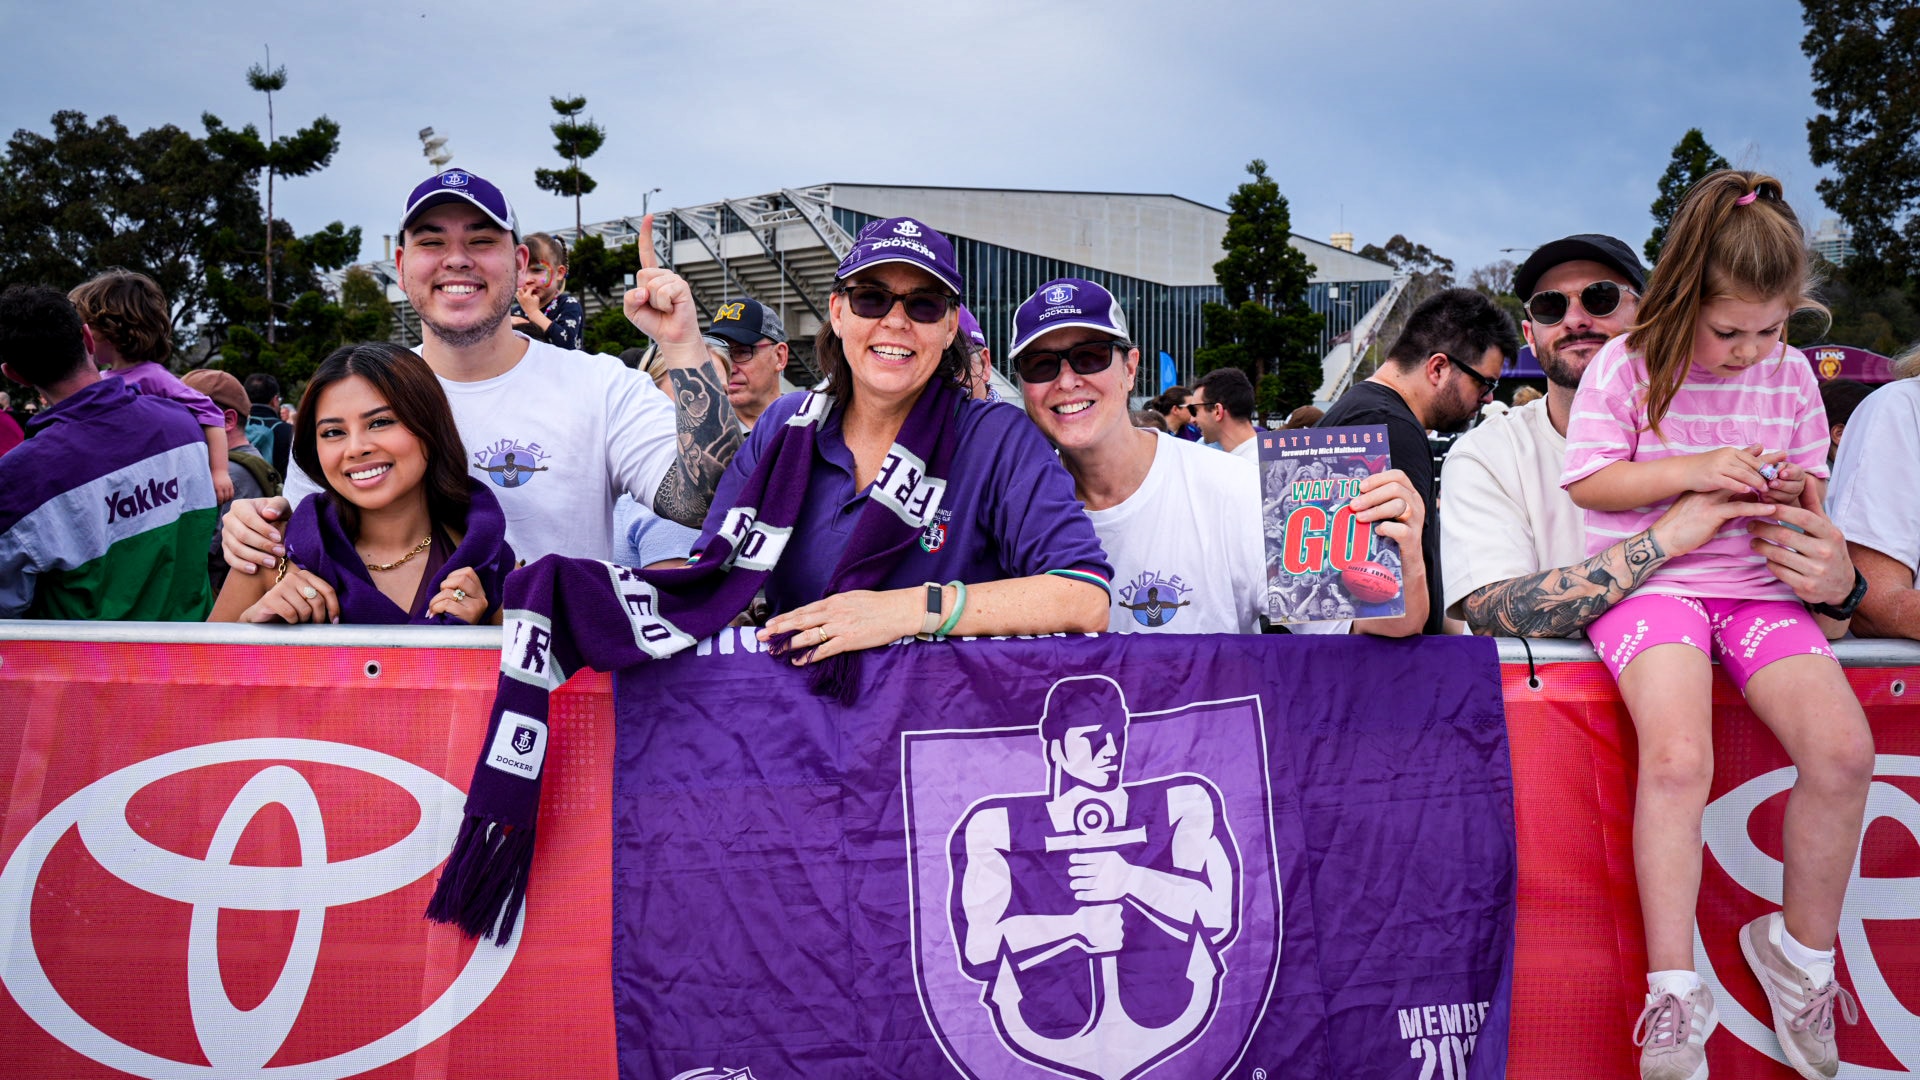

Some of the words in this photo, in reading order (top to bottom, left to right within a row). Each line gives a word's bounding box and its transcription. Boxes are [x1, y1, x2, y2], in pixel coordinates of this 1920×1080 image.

[872, 238, 936, 261] DOCKERS
[713, 302, 746, 323] M
[1039, 308, 1082, 321] DOCKERS
[1815, 351, 1846, 361] LIONS
[1669, 403, 1761, 446] seed
[474, 438, 552, 464] DUDLEY
[1263, 435, 1311, 449] MATT
[1326, 432, 1383, 445] PRICE
[1318, 447, 1334, 455] Mick
[104, 476, 179, 525] Yakka
[1291, 480, 1335, 502] WAY
[1337, 478, 1361, 499] TO
[1282, 502, 1372, 577] GO
[1118, 570, 1194, 601] DUDLEY
[1740, 617, 1766, 646] Seed
[1743, 618, 1799, 659] Heritage
[1611, 633, 1633, 664] Seed
[495, 754, 534, 773] DOCKERS
